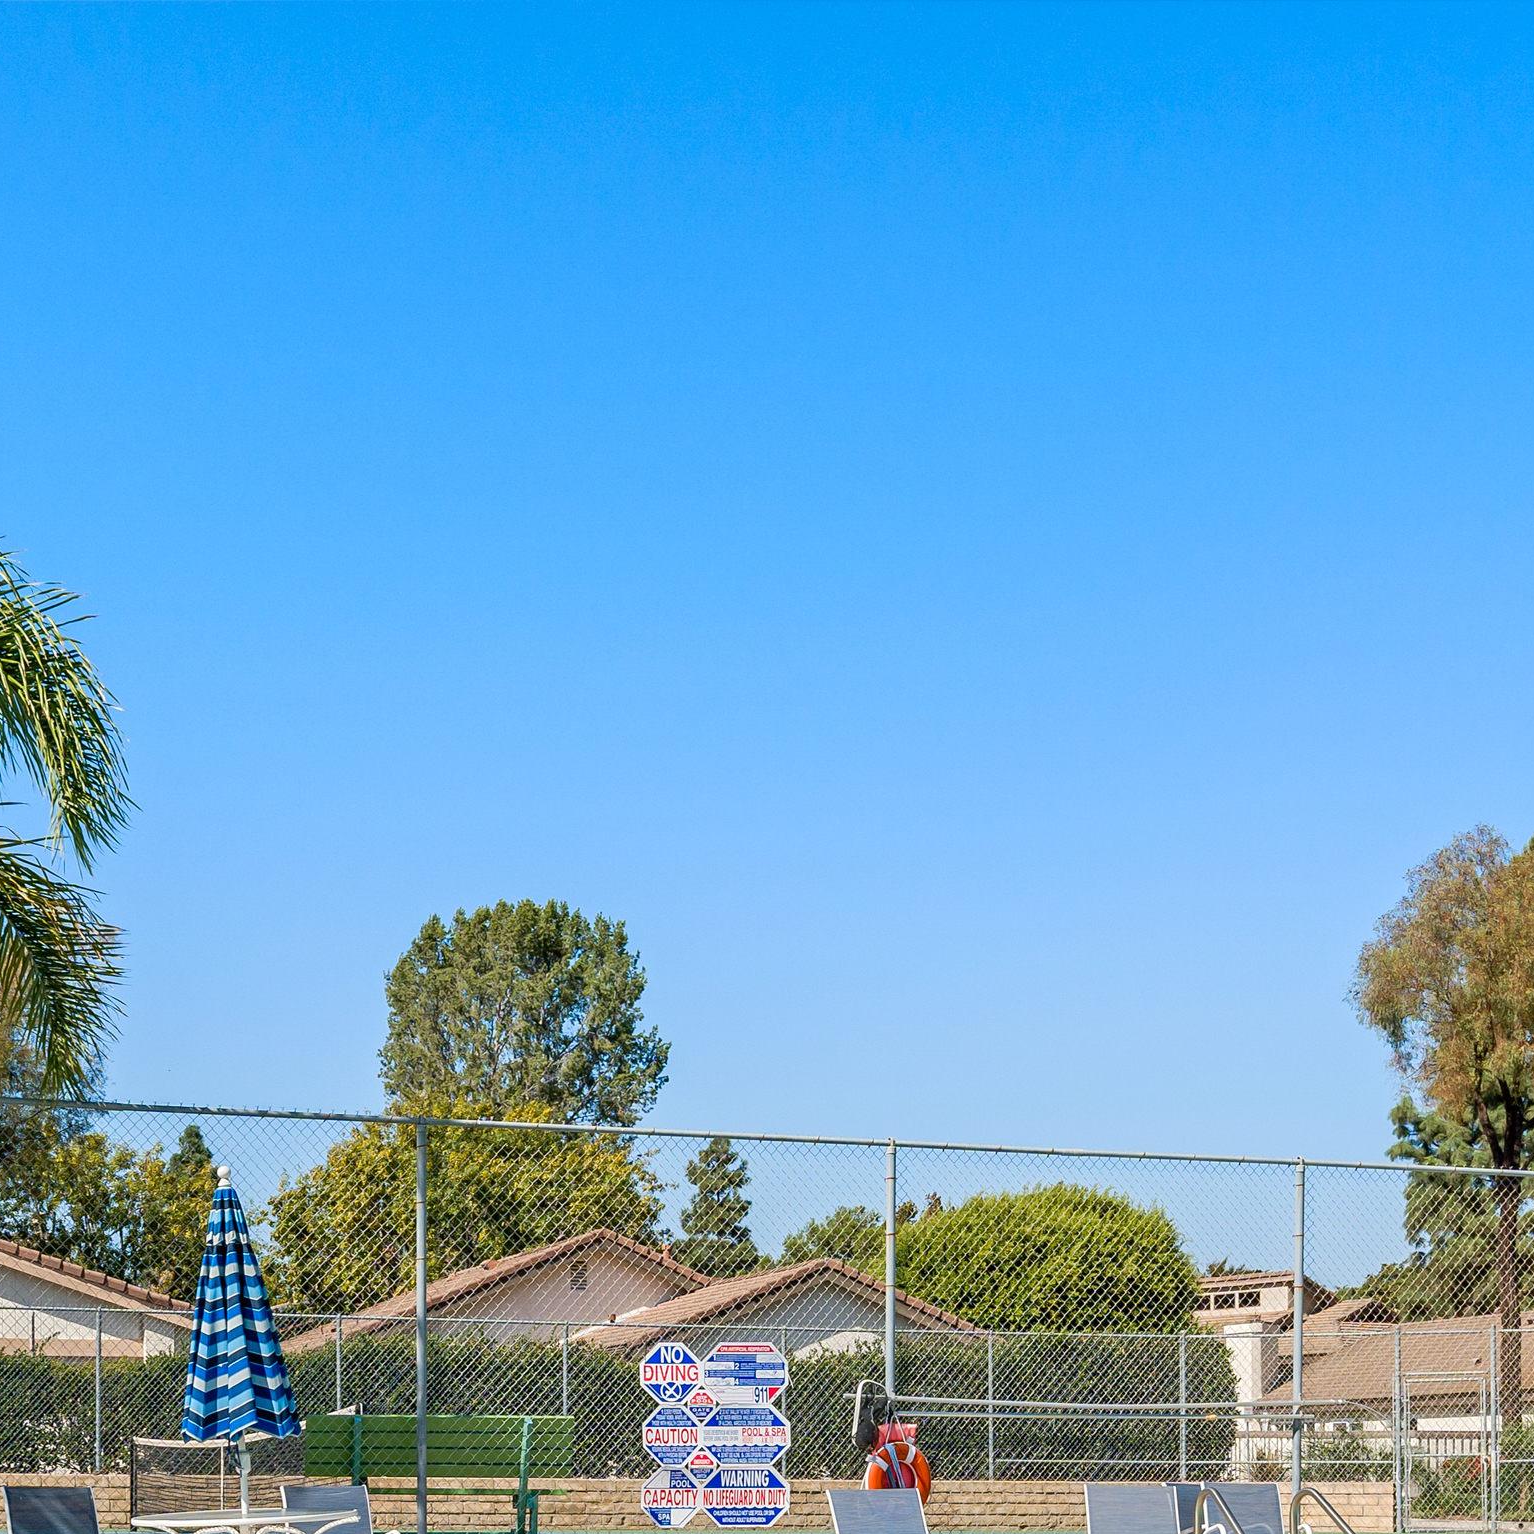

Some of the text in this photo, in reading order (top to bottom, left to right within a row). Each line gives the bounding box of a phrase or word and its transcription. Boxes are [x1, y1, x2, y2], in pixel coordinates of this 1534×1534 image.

[660, 1346, 684, 1364] NO
[643, 1365, 699, 1382] DIVING
[754, 1387, 768, 1404] 911
[645, 1428, 698, 1444] CAUTION
[741, 1428, 763, 1437] POOL
[764, 1428, 770, 1437] &
[771, 1428, 787, 1437] SPA
[670, 1480, 692, 1488] POOL
[720, 1471, 769, 1487] WARNING
[643, 1490, 698, 1506] CAPACITY
[703, 1490, 786, 1506] NO LIFEGUARD ON DUTY
[657, 1513, 670, 1521] SPA
